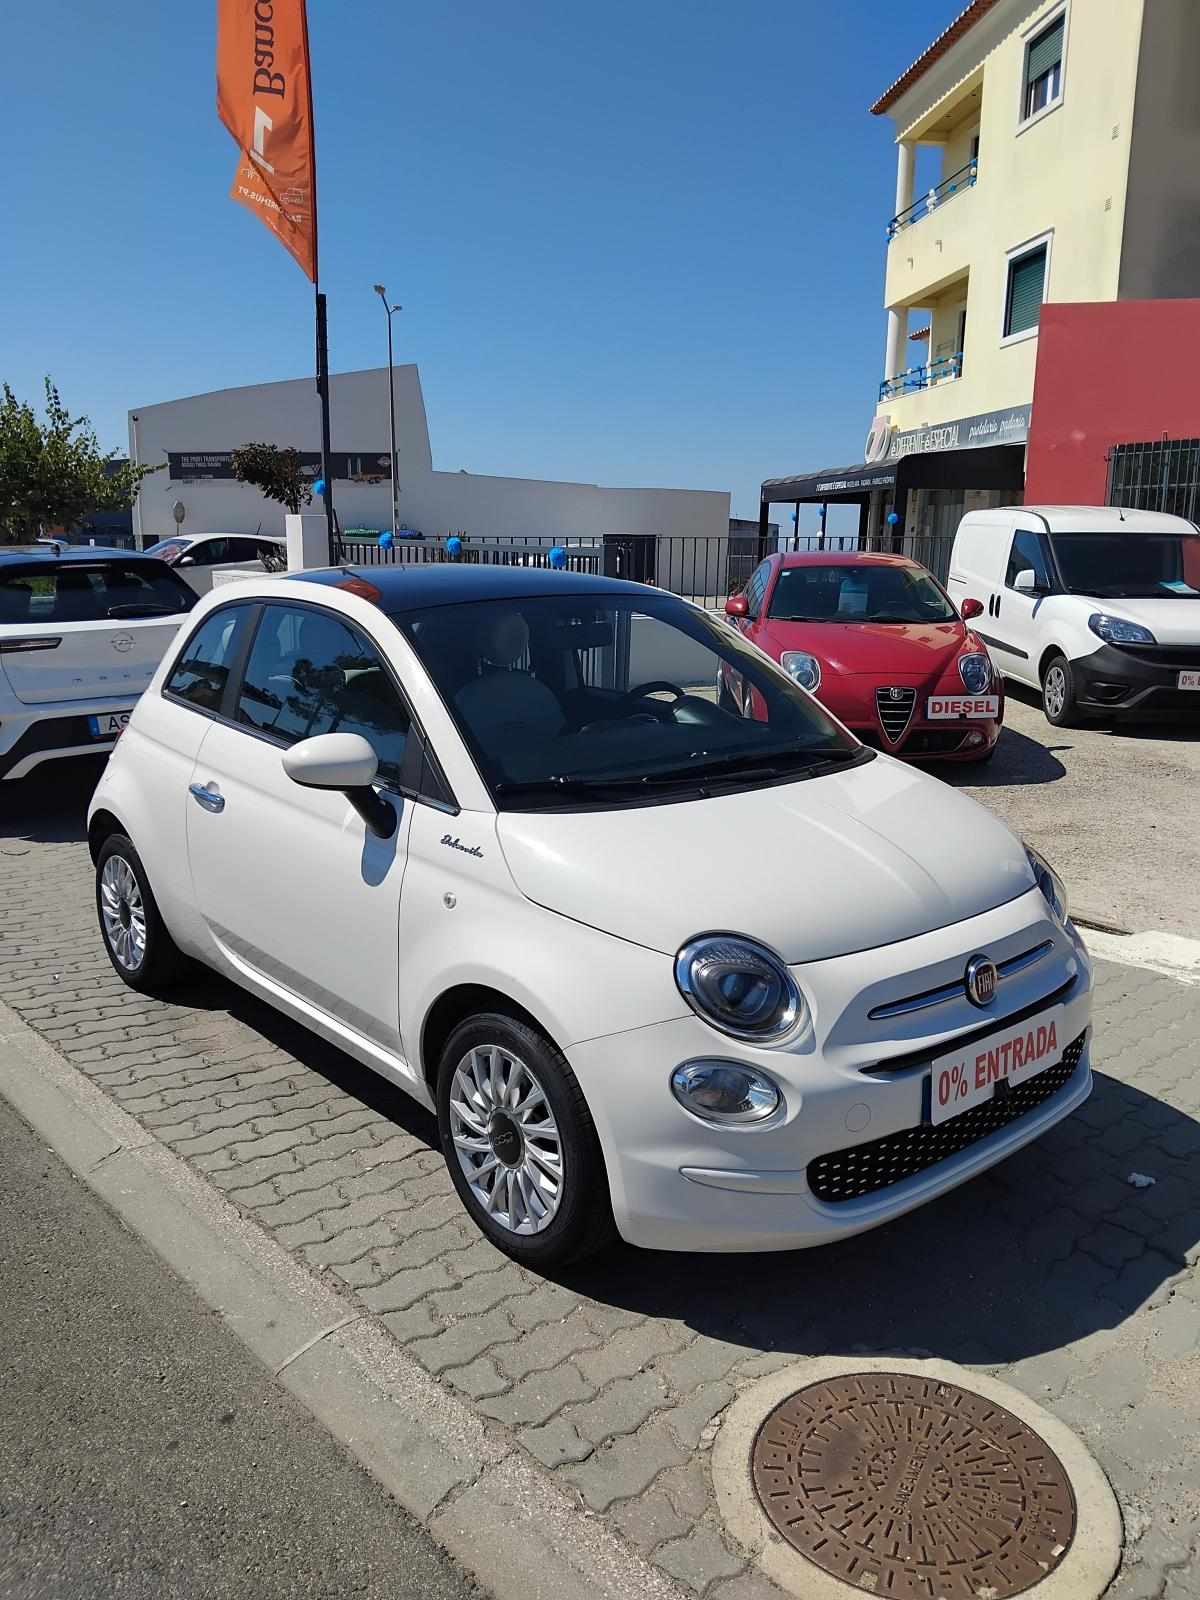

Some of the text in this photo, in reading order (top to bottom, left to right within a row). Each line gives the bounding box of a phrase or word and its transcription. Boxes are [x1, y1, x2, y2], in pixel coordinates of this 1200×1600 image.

[930, 425, 960, 451] ESPECIAL
[931, 700, 995, 714] DIESEL
[977, 971, 993, 994] FIAT
[939, 1021, 1058, 1106] 0% ENTRADA
